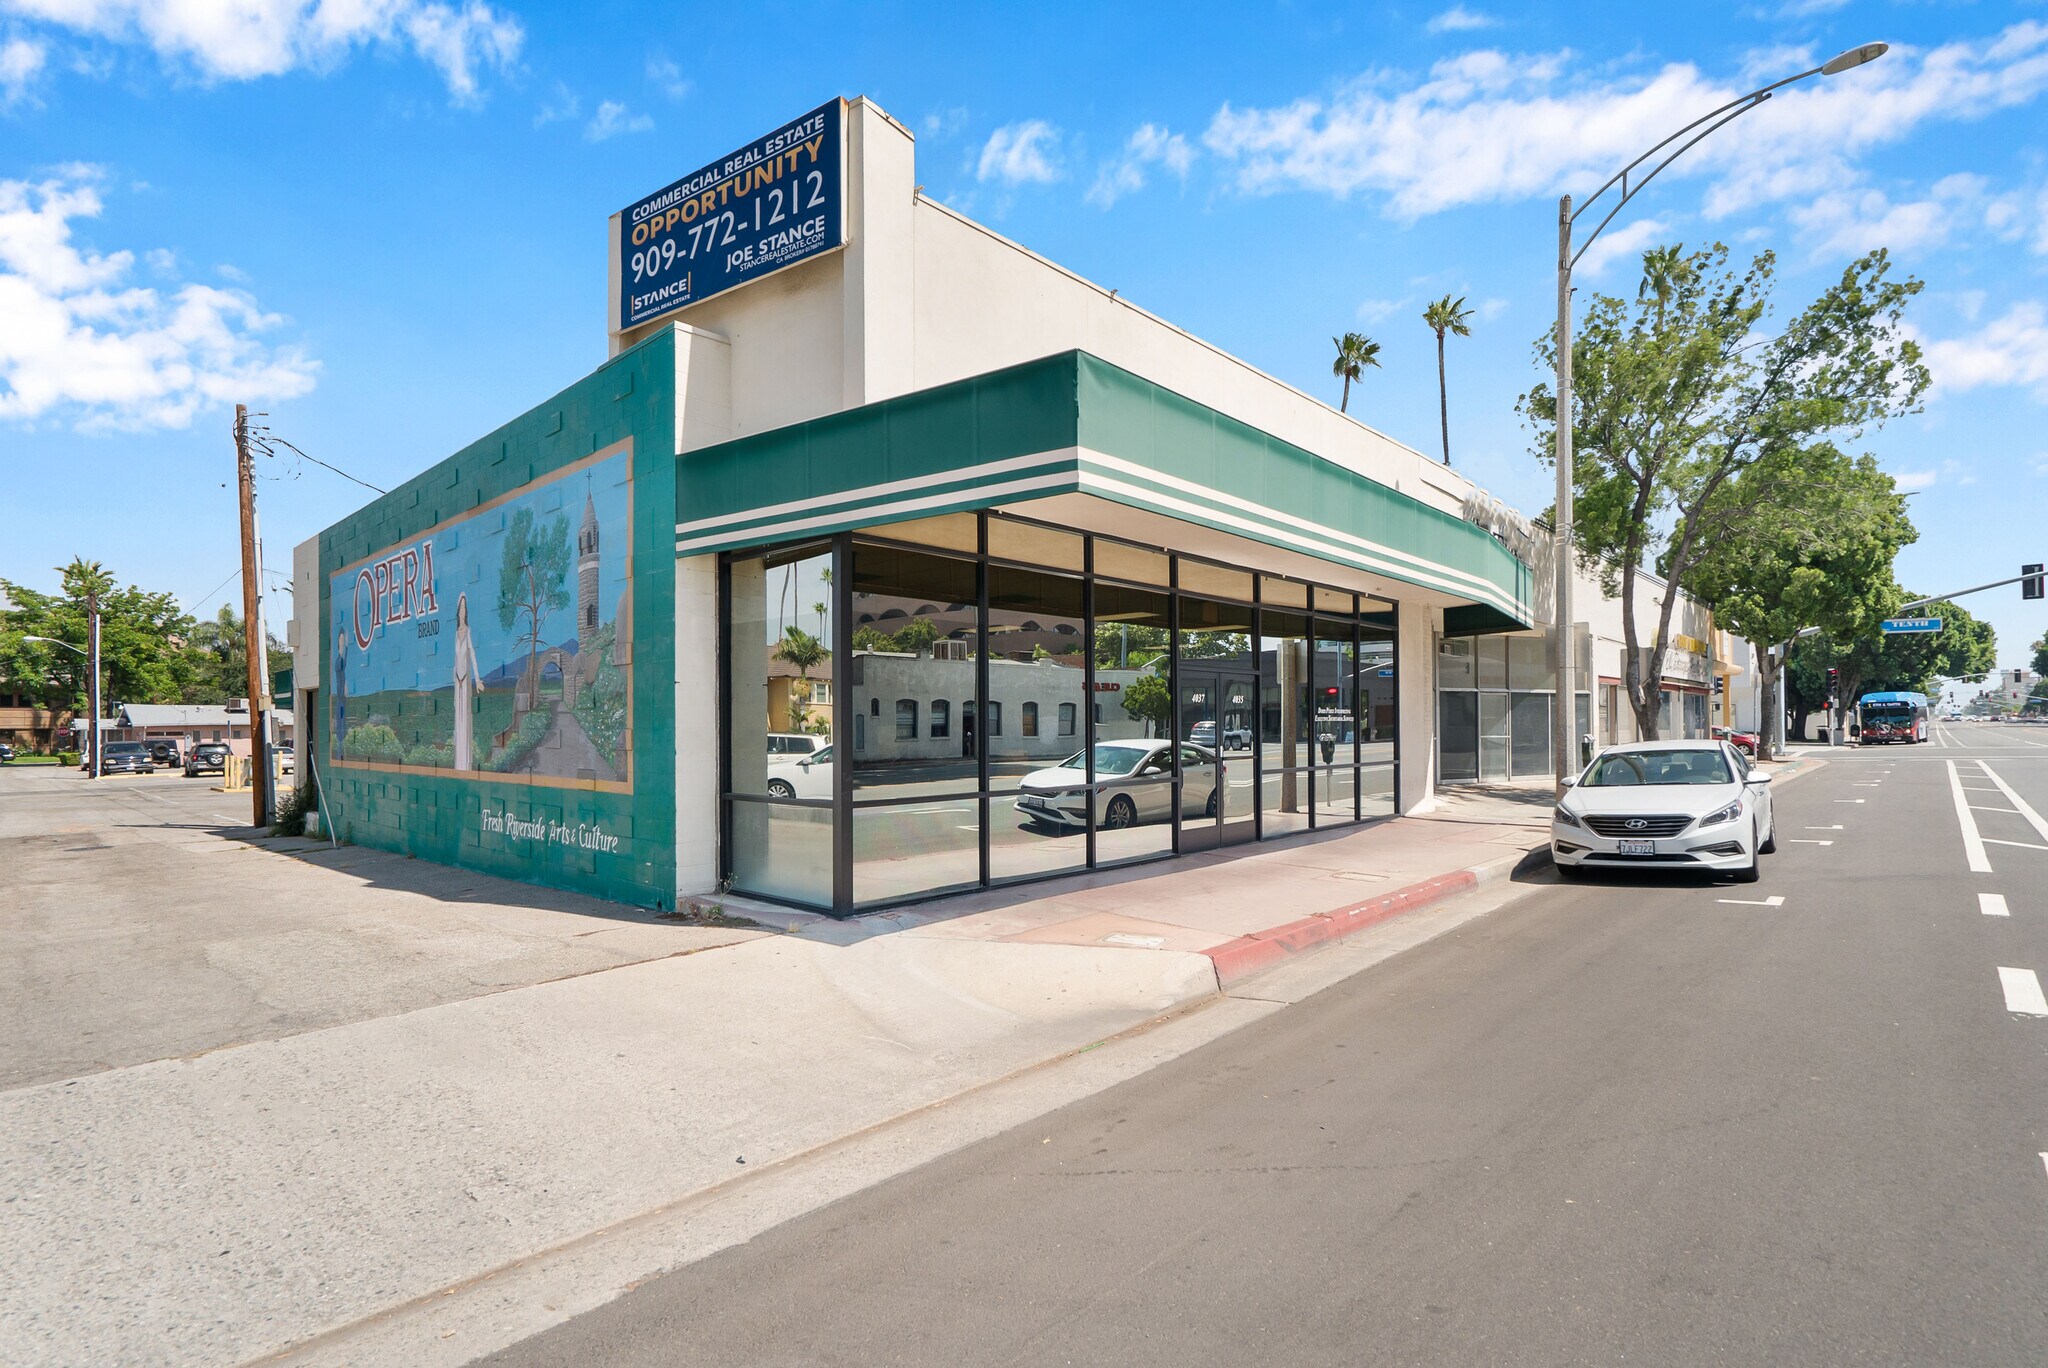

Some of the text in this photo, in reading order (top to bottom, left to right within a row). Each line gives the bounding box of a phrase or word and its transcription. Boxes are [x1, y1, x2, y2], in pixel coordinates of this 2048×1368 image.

[631, 134, 824, 246] OPPORTUNITY
[632, 113, 825, 221] COMMERCIAL REAL ESTATE
[631, 170, 825, 284] 909-772-1212
[725, 215, 825, 274] JOE STANCE
[739, 231, 825, 272] STANCEREALESTATE.COM
[353, 540, 439, 651] OPERA
[418, 619, 440, 639] BRAND
[1191, 693, 1244, 704] 4037 4035
[481, 809, 619, 854] Fresh Riverside Arts & Culture
